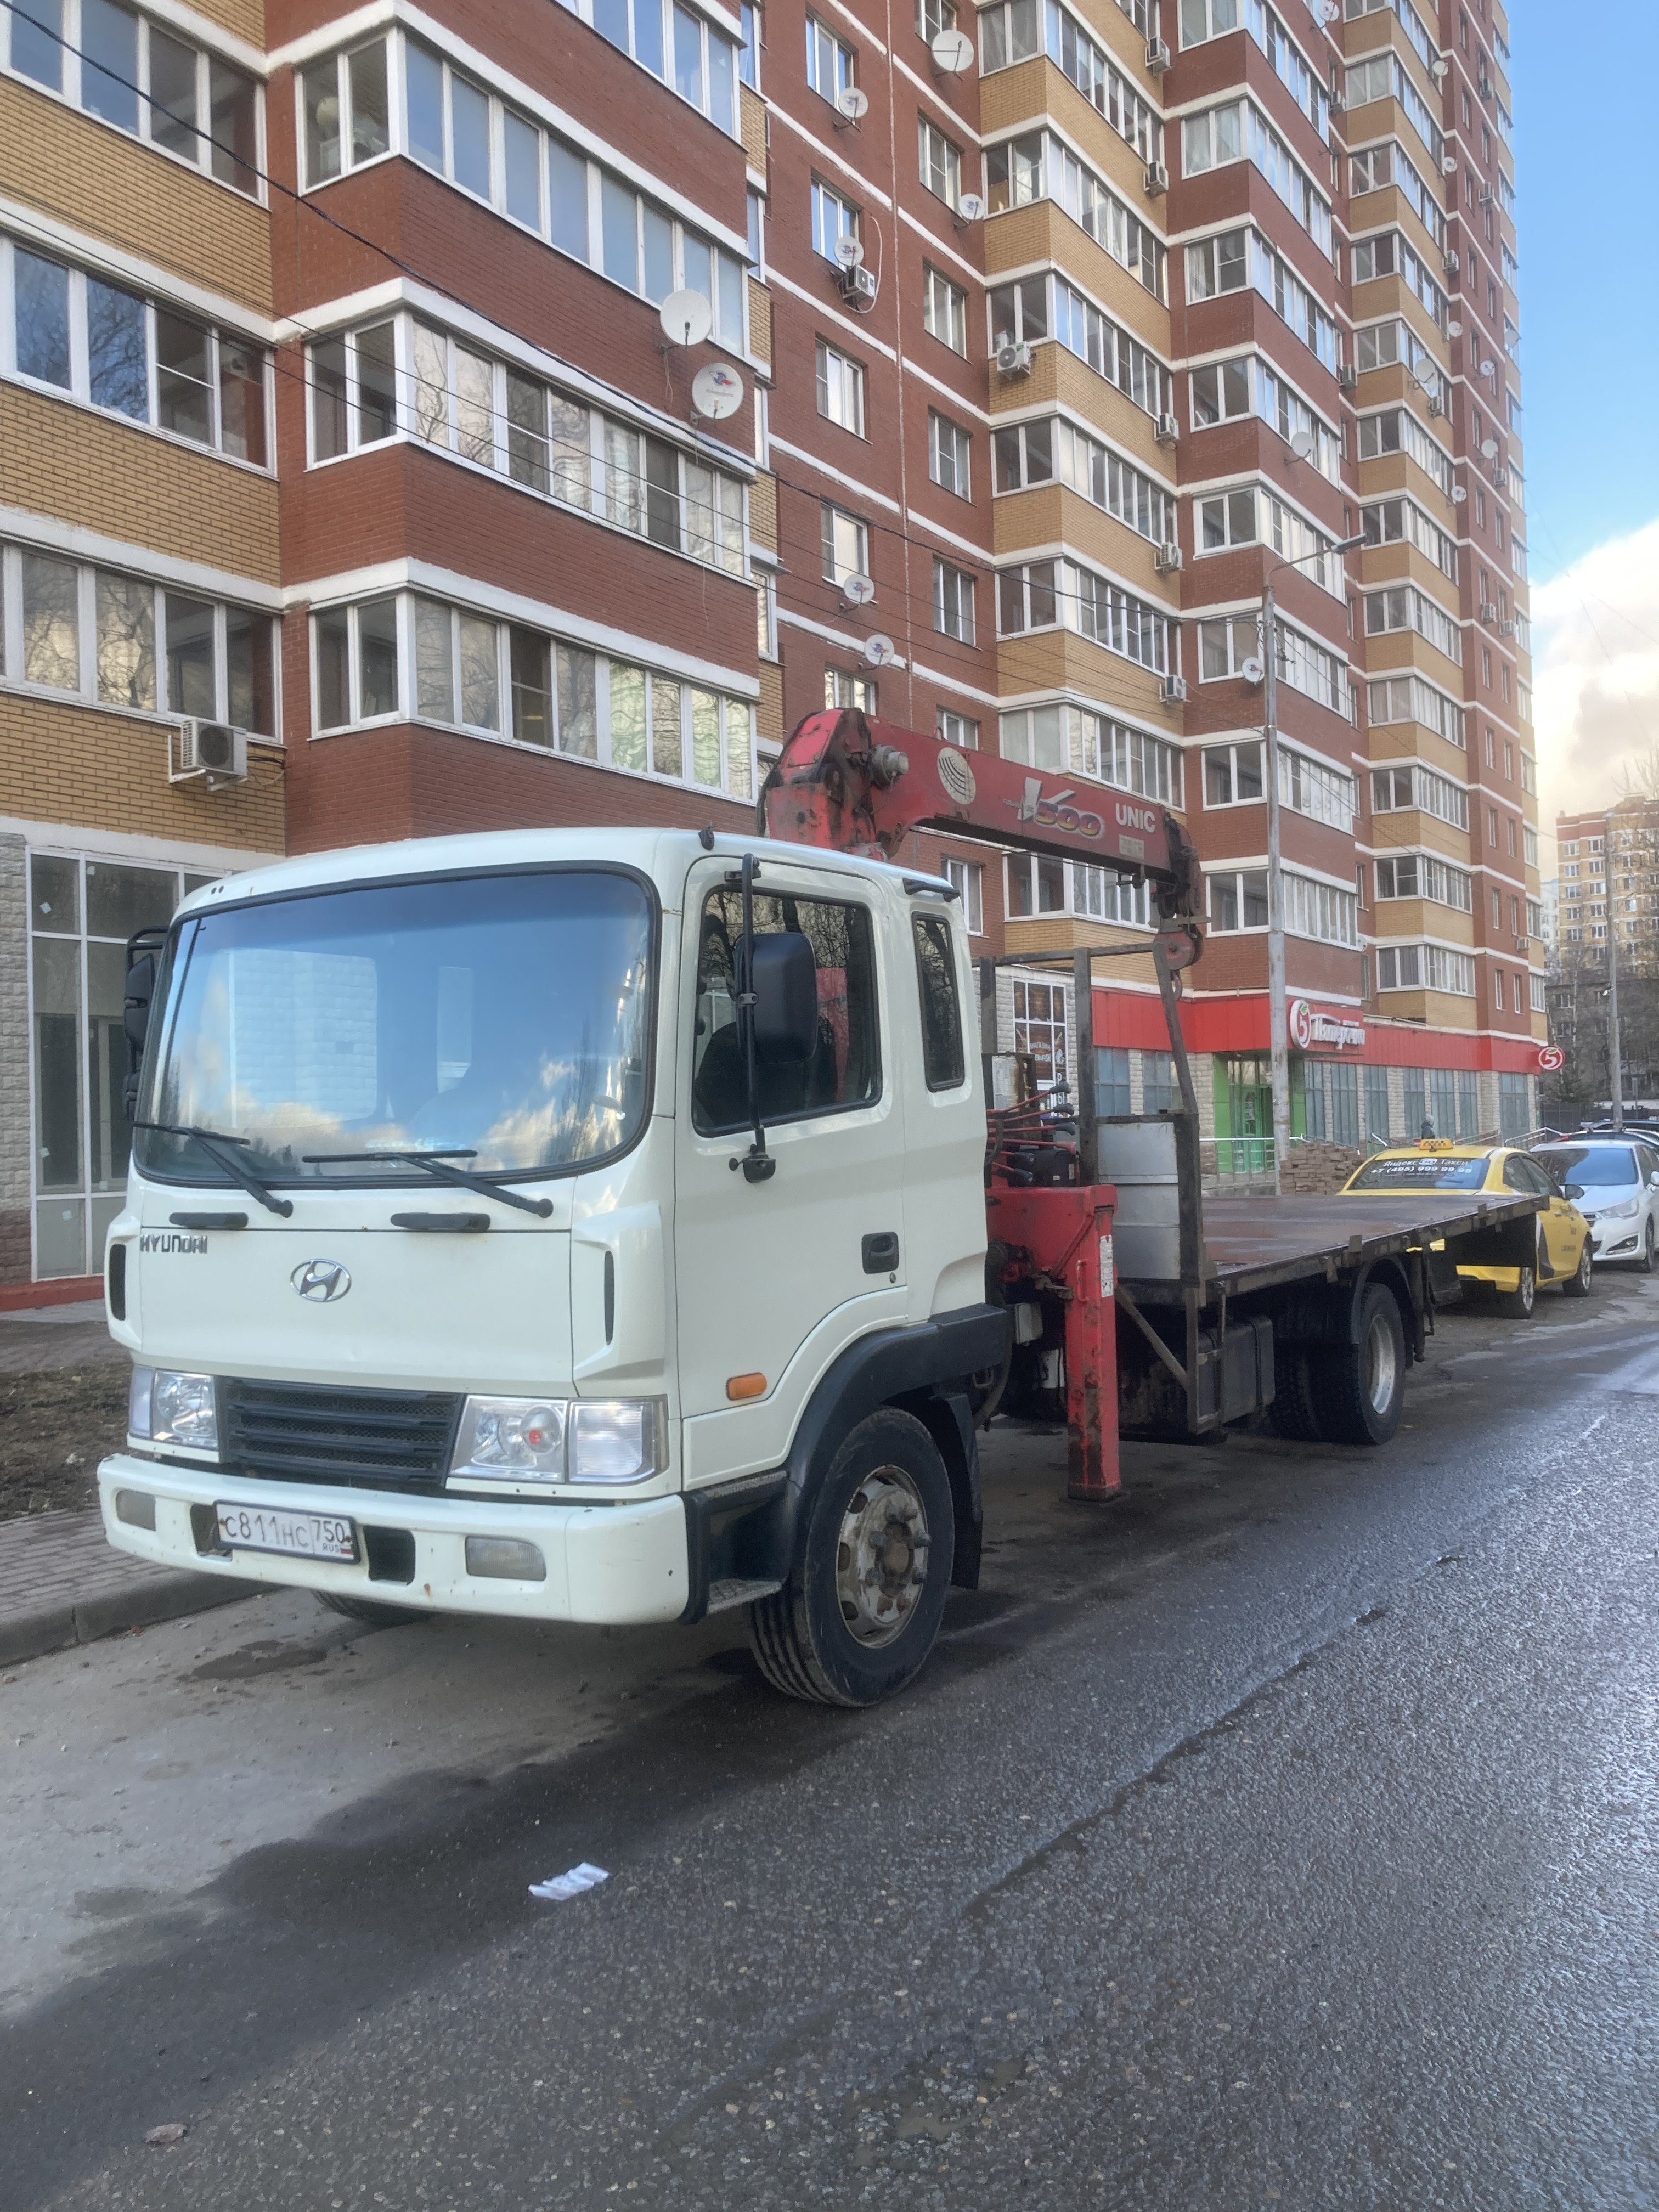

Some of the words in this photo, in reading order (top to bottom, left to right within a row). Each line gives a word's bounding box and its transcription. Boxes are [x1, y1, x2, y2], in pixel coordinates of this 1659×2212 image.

[1115, 803, 1156, 833] UNIC
[140, 1235, 208, 1254] HYUNDAI
[311, 1519, 345, 1543] 750
[323, 1542, 340, 1553] RUS
